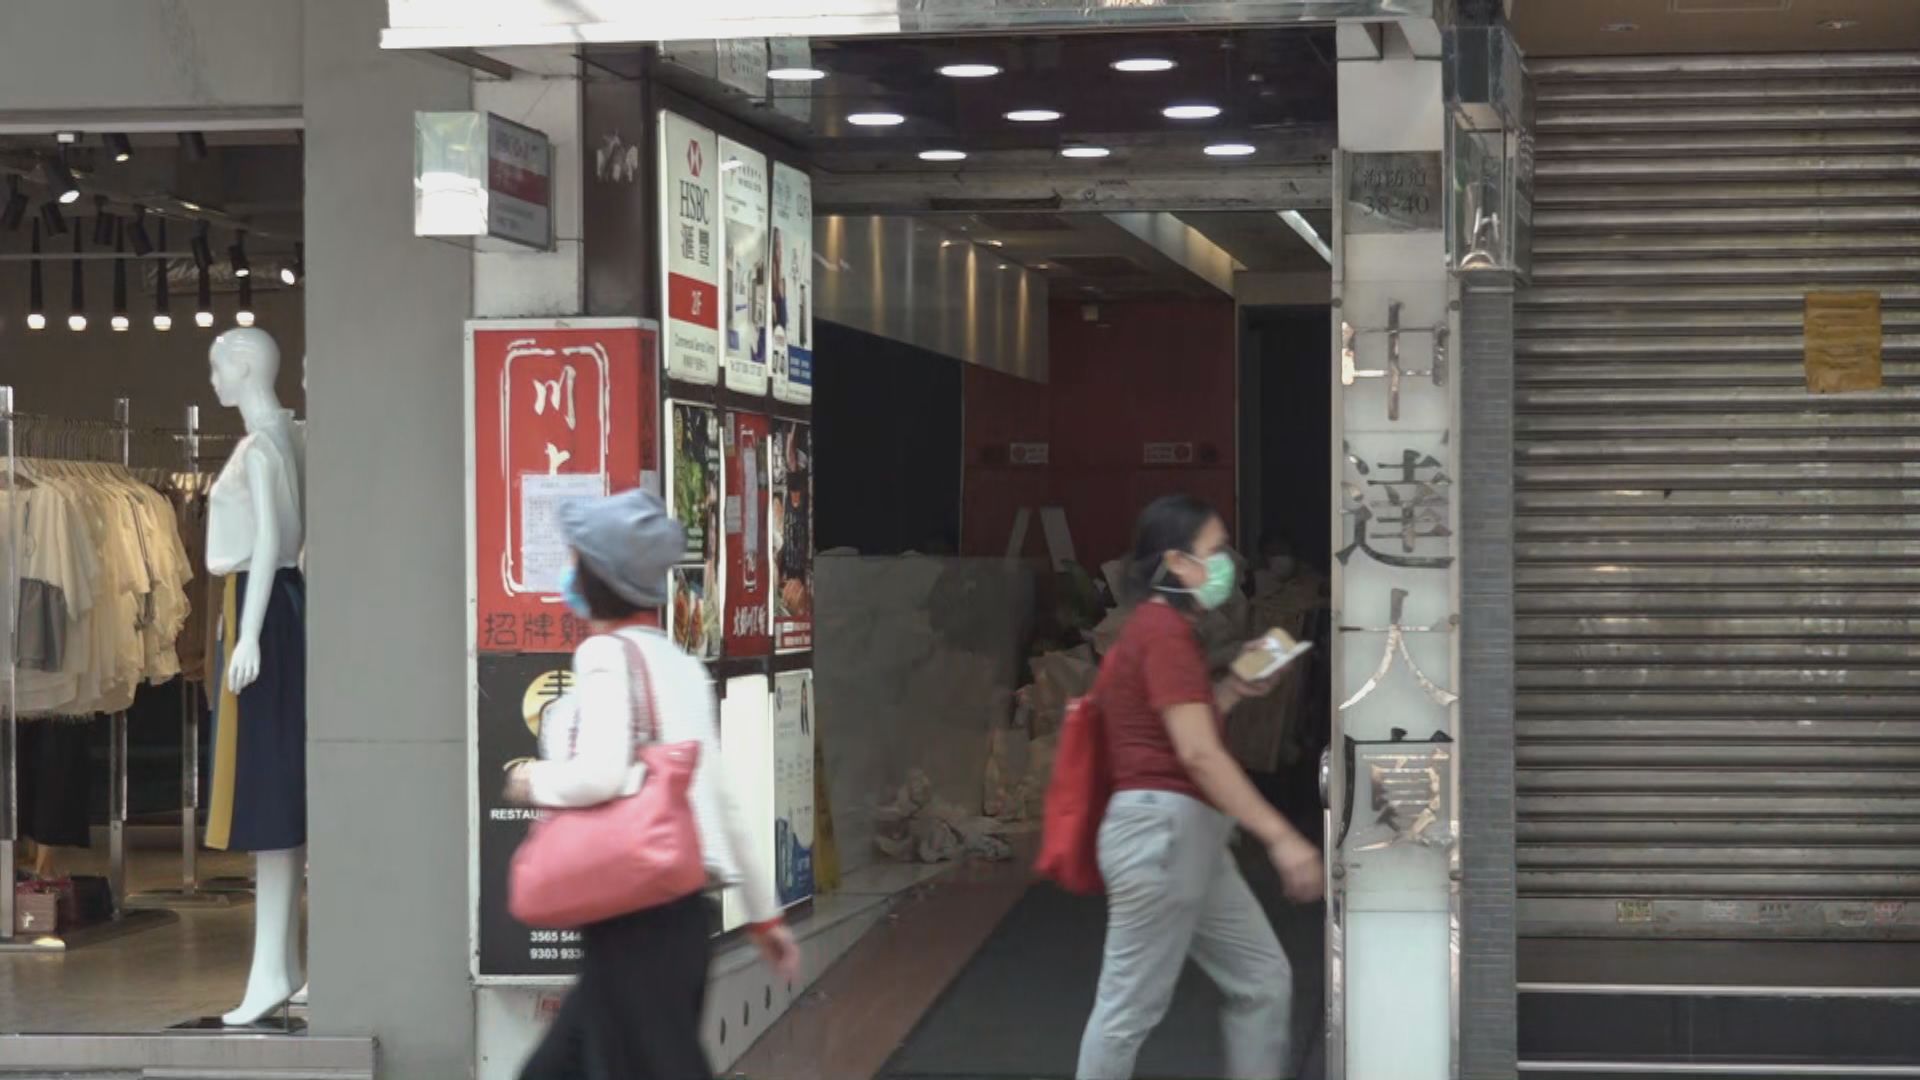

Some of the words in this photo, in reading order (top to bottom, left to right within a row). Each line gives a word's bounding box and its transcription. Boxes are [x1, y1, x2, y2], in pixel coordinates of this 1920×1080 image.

[680, 180, 711, 225] HSBC
[1362, 195, 1430, 216] 38-40
[530, 931, 559, 942] 3565
[530, 947, 559, 958] 9303
